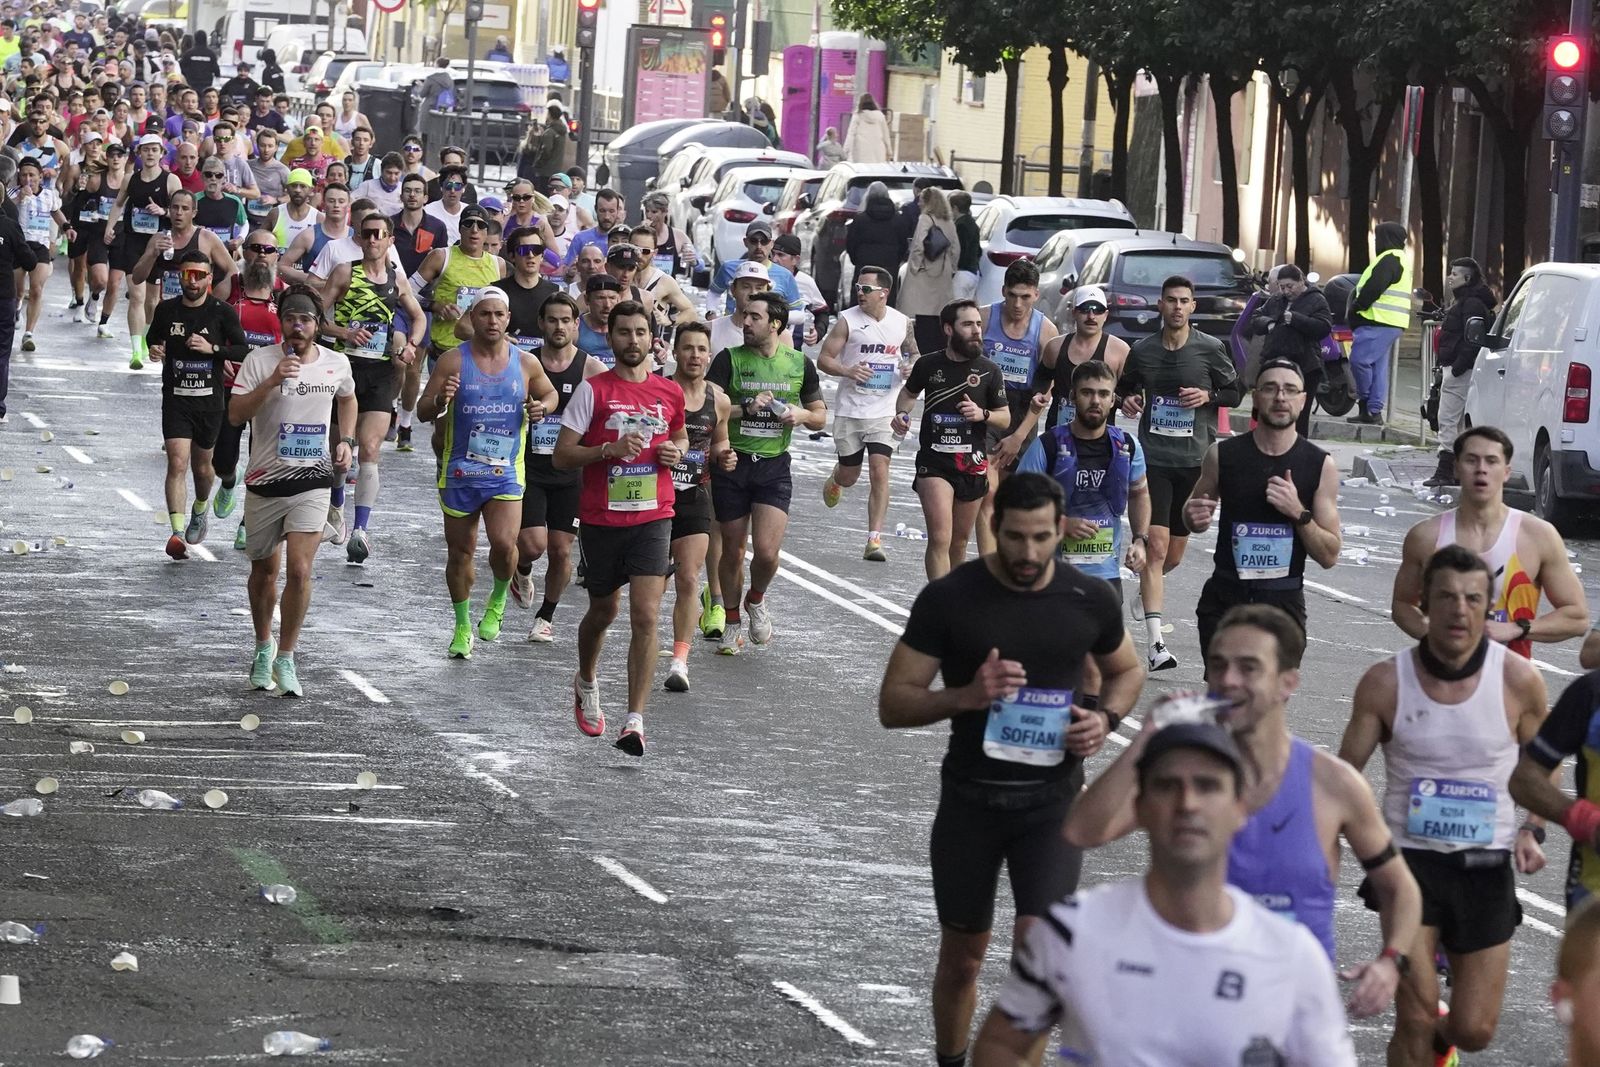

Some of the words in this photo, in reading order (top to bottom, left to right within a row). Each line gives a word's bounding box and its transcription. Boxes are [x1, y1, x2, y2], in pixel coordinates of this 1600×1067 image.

[248, 333, 271, 341] ZURICH
[518, 337, 540, 346] ZURICH
[860, 343, 899, 355] MRW
[1005, 345, 1028, 356] ZURICH
[999, 364, 1028, 375] XANDER
[180, 379, 205, 388] ALLAN
[547, 416, 561, 424] ZUR
[741, 420, 766, 429] IGNACIO
[766, 421, 784, 430] PÉREZ
[1151, 417, 1193, 428] ALEJANDRO
[296, 424, 322, 433] ZURICH
[940, 434, 962, 444] SUSO
[280, 446, 323, 457] @LEIVA95
[625, 465, 653, 474] ZURICH
[1075, 469, 1107, 488] CV
[626, 480, 643, 488] 2930
[625, 490, 643, 500] J.E.
[1251, 527, 1287, 536] ZURICH
[1061, 543, 1071, 553] A.
[1073, 542, 1113, 553] JIMENEZ
[1251, 543, 1271, 552] 8250
[1240, 554, 1280, 566] PAWEŁ
[1022, 691, 1066, 705] ZURICH
[1001, 725, 1057, 746] SOFIAN
[1440, 784, 1489, 798] ZURICH
[1422, 820, 1480, 840] FAMILY
